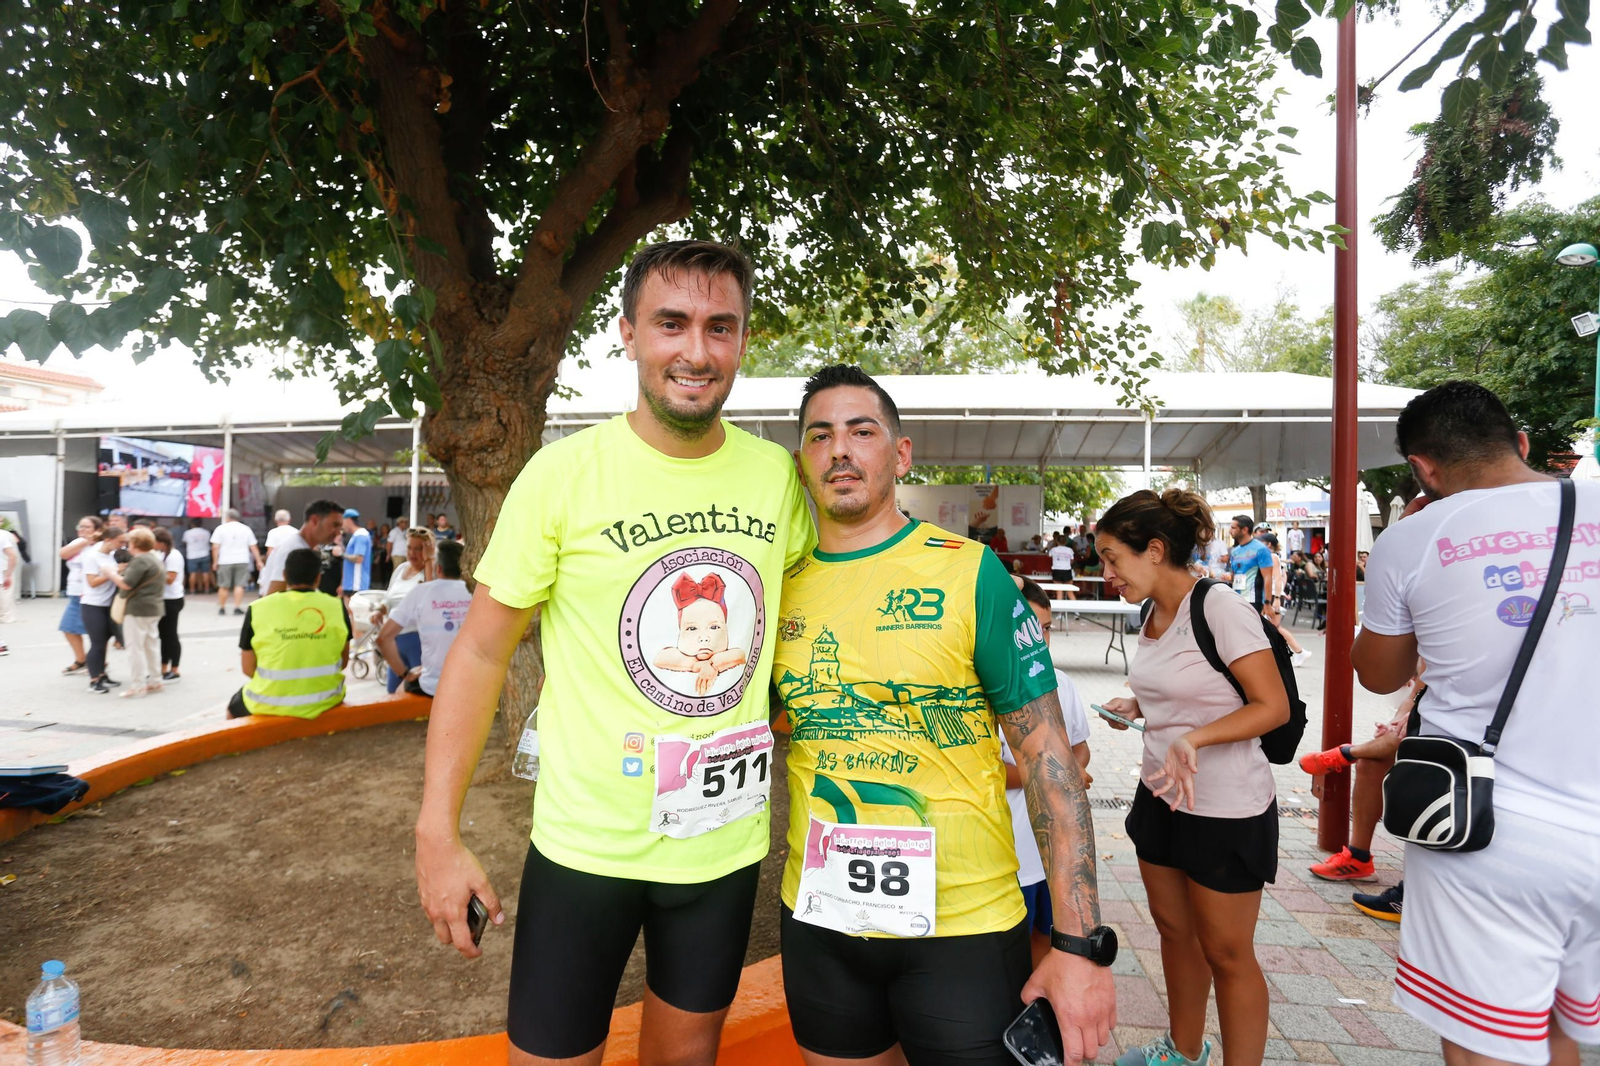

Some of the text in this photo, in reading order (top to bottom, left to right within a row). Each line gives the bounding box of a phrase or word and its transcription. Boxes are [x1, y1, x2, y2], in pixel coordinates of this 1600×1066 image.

[600, 503, 776, 552] Valentina
[1288, 507, 1308, 517] VITO
[660, 549, 744, 574] Asociación
[876, 624, 904, 632] RUNNERS
[627, 656, 646, 679] El
[640, 677, 694, 713] camino
[696, 700, 715, 713] de
[702, 752, 767, 798] 511
[848, 859, 910, 897] 98
[862, 900, 896, 909] FRANCISCO
